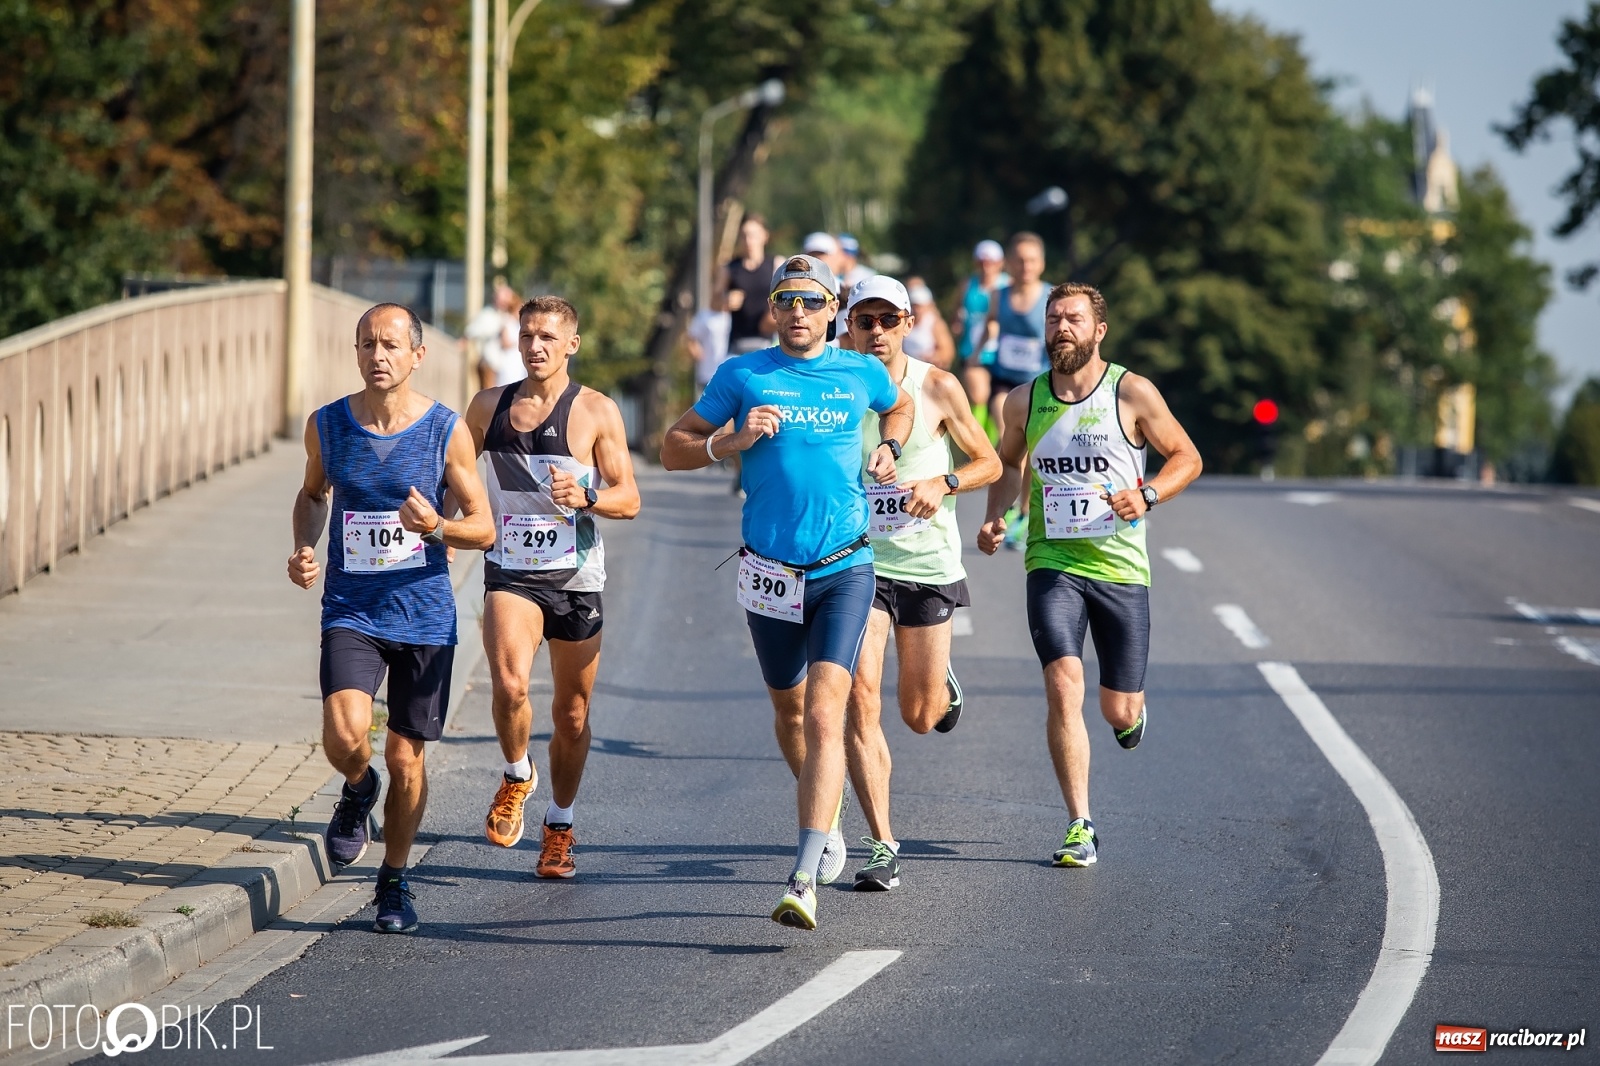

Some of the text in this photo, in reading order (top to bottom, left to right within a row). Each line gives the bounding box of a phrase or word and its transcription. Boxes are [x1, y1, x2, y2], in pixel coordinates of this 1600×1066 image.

[779, 407, 849, 425] RAKÓW
[1037, 406, 1059, 414] deep
[1071, 433, 1109, 442] AKTYWNI
[874, 496, 907, 515] 286
[1069, 499, 1089, 516] 17
[368, 527, 405, 548] 104
[523, 530, 558, 548] 299
[820, 548, 854, 565] CANYON
[752, 573, 786, 598] 390
